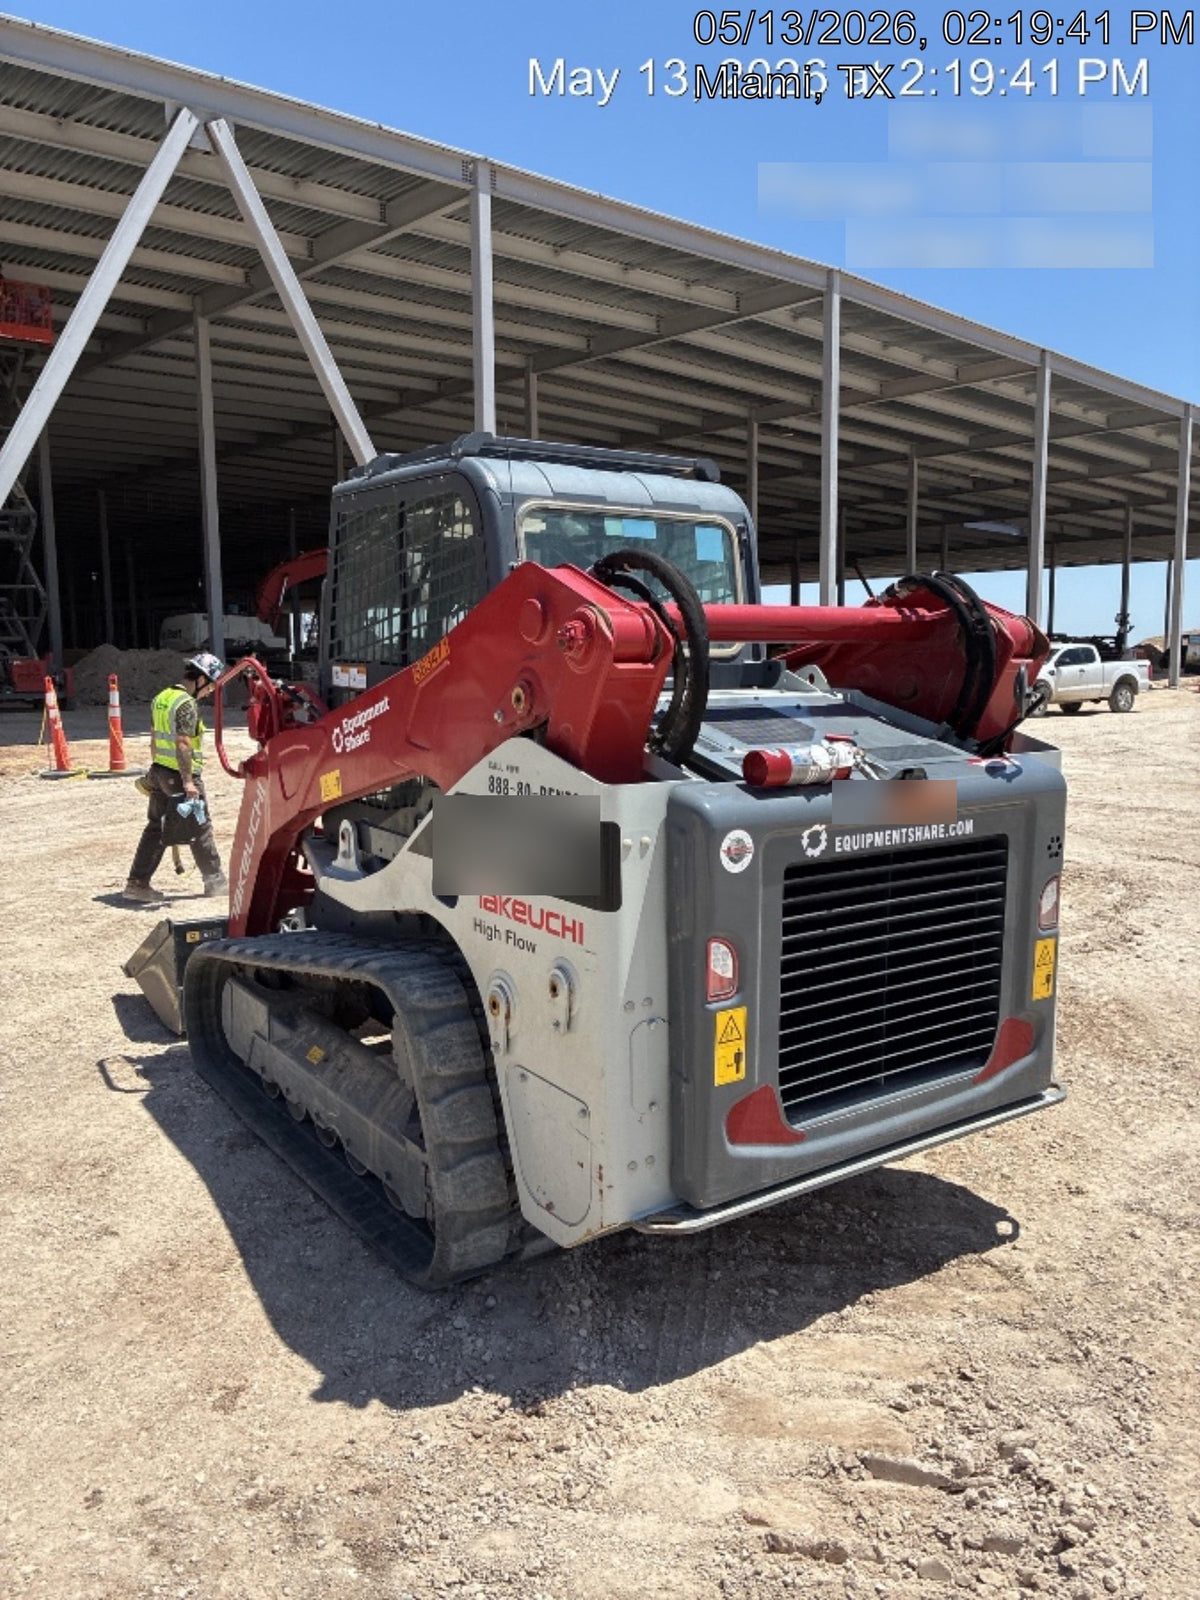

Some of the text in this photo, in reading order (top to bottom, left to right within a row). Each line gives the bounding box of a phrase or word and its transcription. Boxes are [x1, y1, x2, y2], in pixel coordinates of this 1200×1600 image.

[342, 696, 390, 734] Equipment
[344, 733, 371, 752] Share
[834, 818, 974, 853] EQUIPMENTSHARE.COM
[473, 917, 537, 954] High Flow
